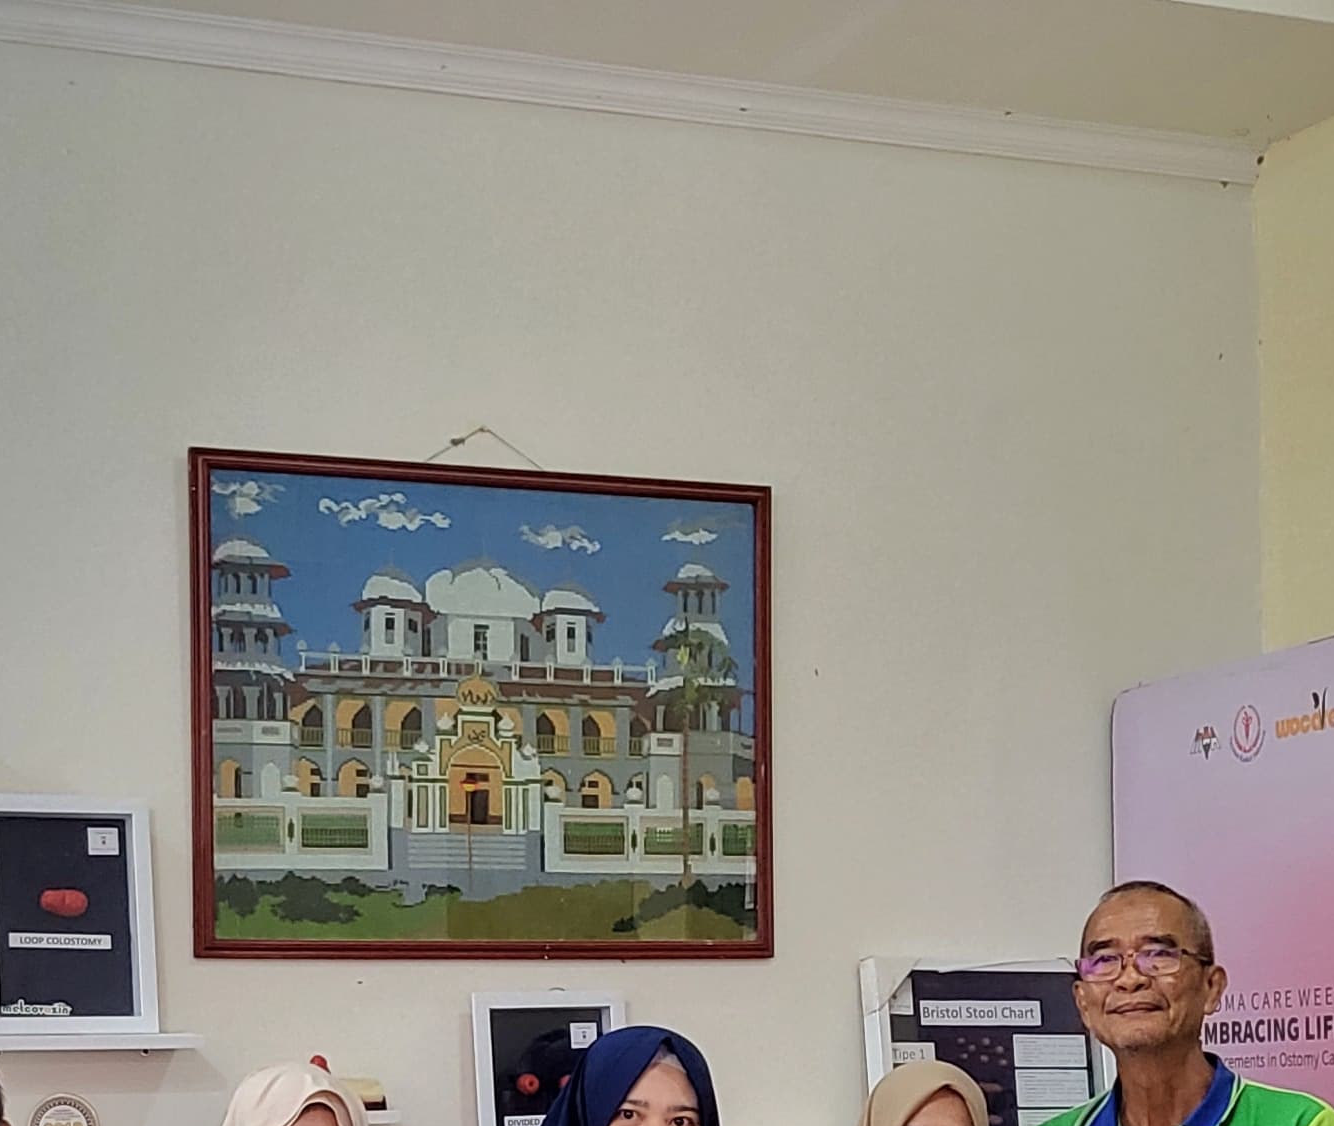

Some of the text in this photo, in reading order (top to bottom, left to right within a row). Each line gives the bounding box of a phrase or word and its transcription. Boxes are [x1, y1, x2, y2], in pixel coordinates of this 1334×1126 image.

[19, 936, 103, 946] LOOP COLOSTOMY
[1251, 989, 1293, 1011] CARE
[922, 1006, 1035, 1020] Bristol Stool Chart
[1202, 1017, 1300, 1046] MBRACING
[893, 1049, 926, 1063] Tipe 1
[1268, 1053, 1278, 1068] in
[1279, 1051, 1318, 1070] Ostomy
[507, 1118, 540, 1126] DIVIDED
